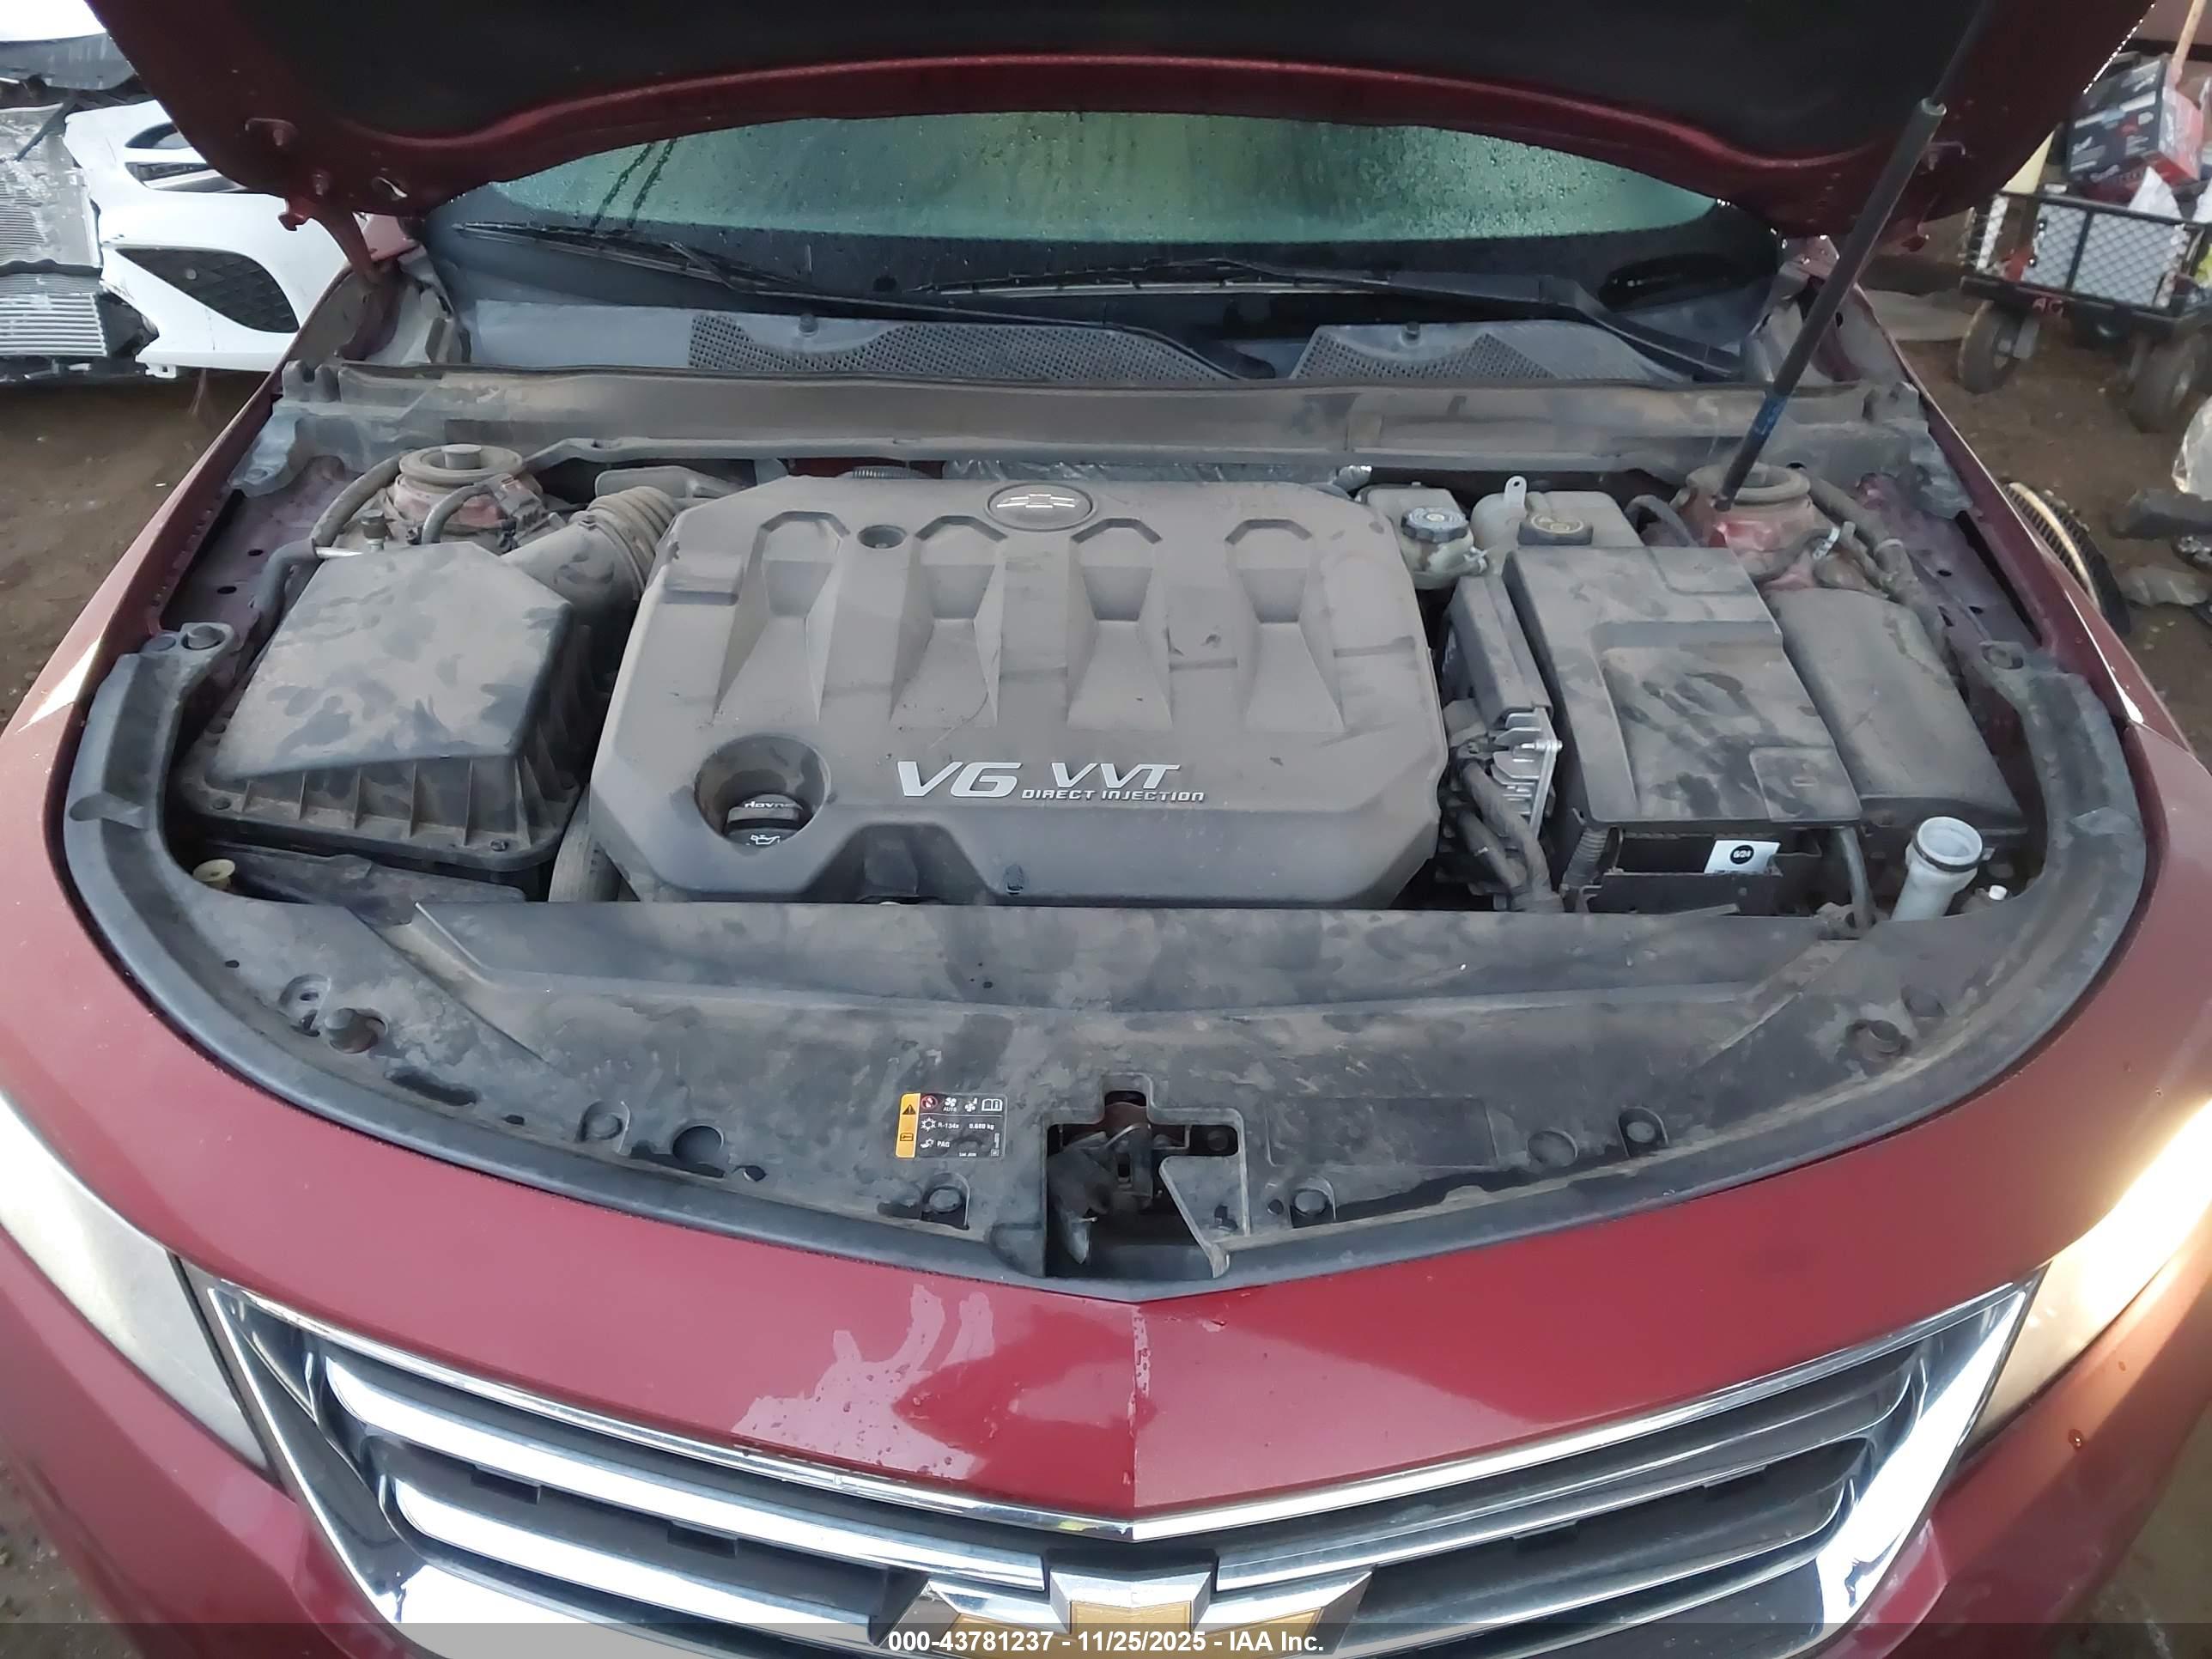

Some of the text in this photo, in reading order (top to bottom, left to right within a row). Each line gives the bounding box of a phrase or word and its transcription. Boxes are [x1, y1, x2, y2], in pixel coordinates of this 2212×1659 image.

[897, 762, 1181, 798] V6 VVT
[1021, 789, 1206, 802] DIRECT INJECTION
